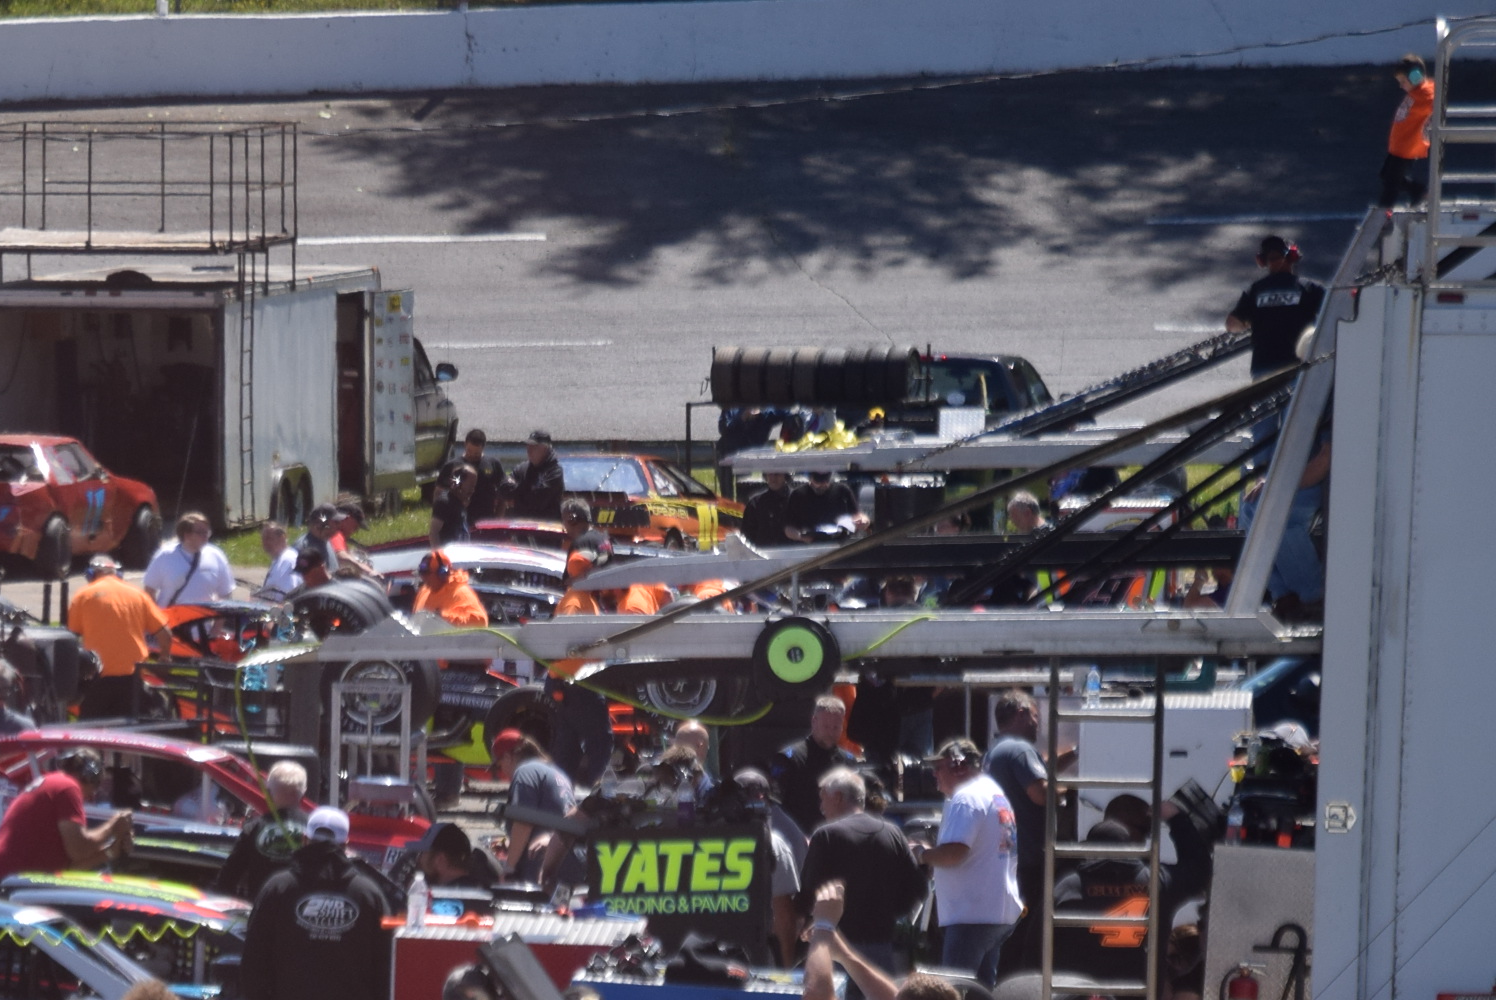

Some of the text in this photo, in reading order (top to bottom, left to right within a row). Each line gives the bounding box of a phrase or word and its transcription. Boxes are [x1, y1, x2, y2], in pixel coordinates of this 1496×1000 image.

[595, 839, 756, 894] YATES
[605, 896, 749, 914] GRADING & PAVING
[1089, 897, 1149, 948] 4
